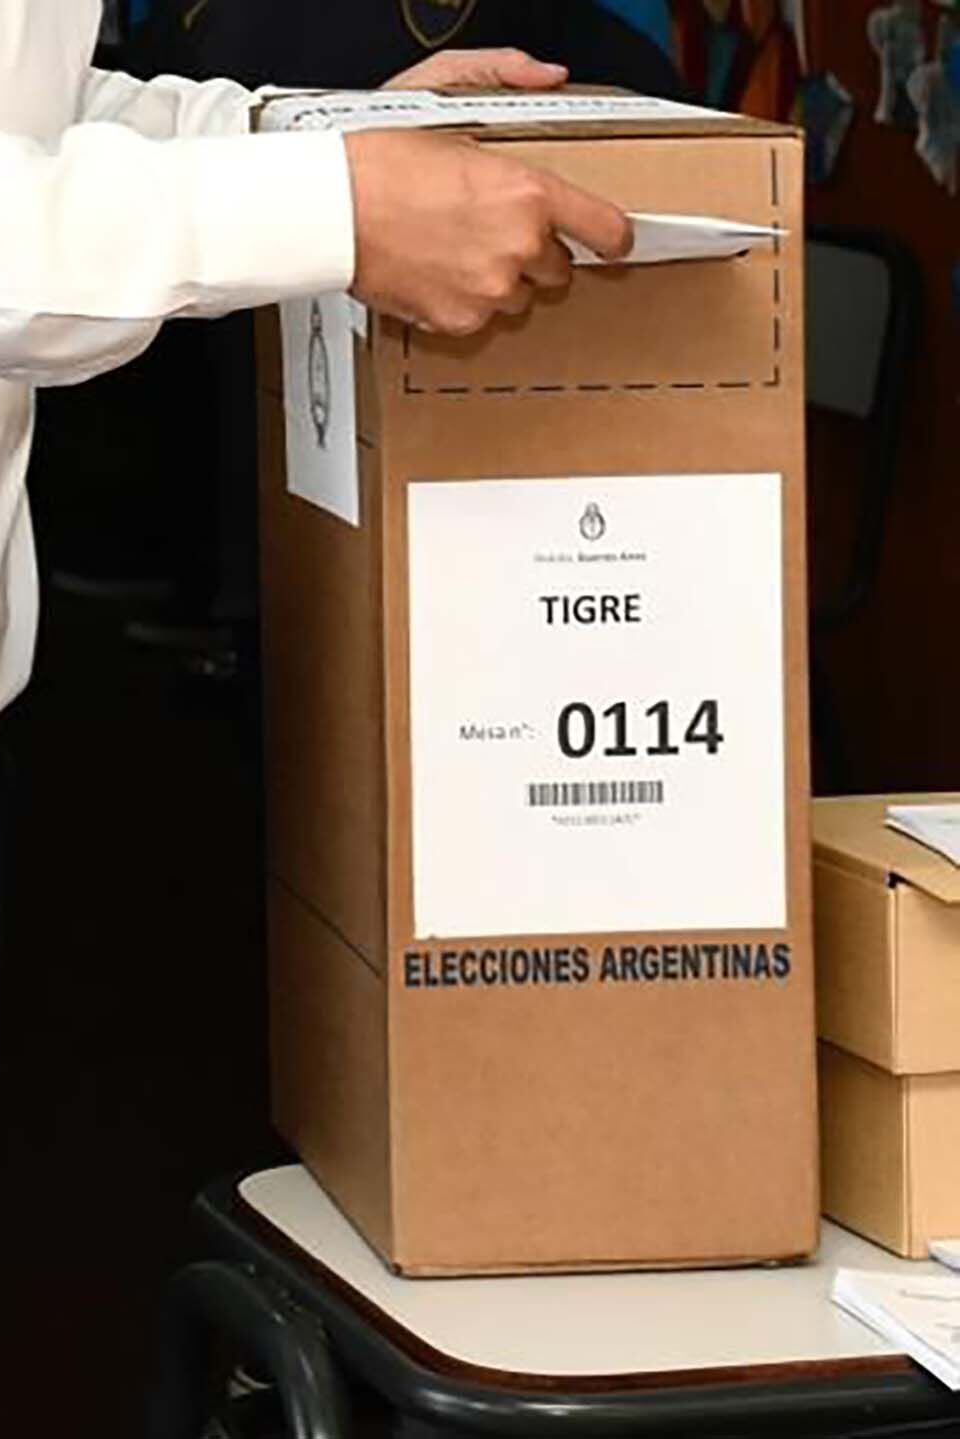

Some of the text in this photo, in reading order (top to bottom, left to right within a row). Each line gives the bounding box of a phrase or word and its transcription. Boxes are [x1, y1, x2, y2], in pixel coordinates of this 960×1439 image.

[539, 594, 642, 625] TIGRE
[459, 724, 507, 741] Mesa
[557, 699, 725, 759] 0114
[404, 943, 791, 987] ELECCIONES ARGENTINAS
